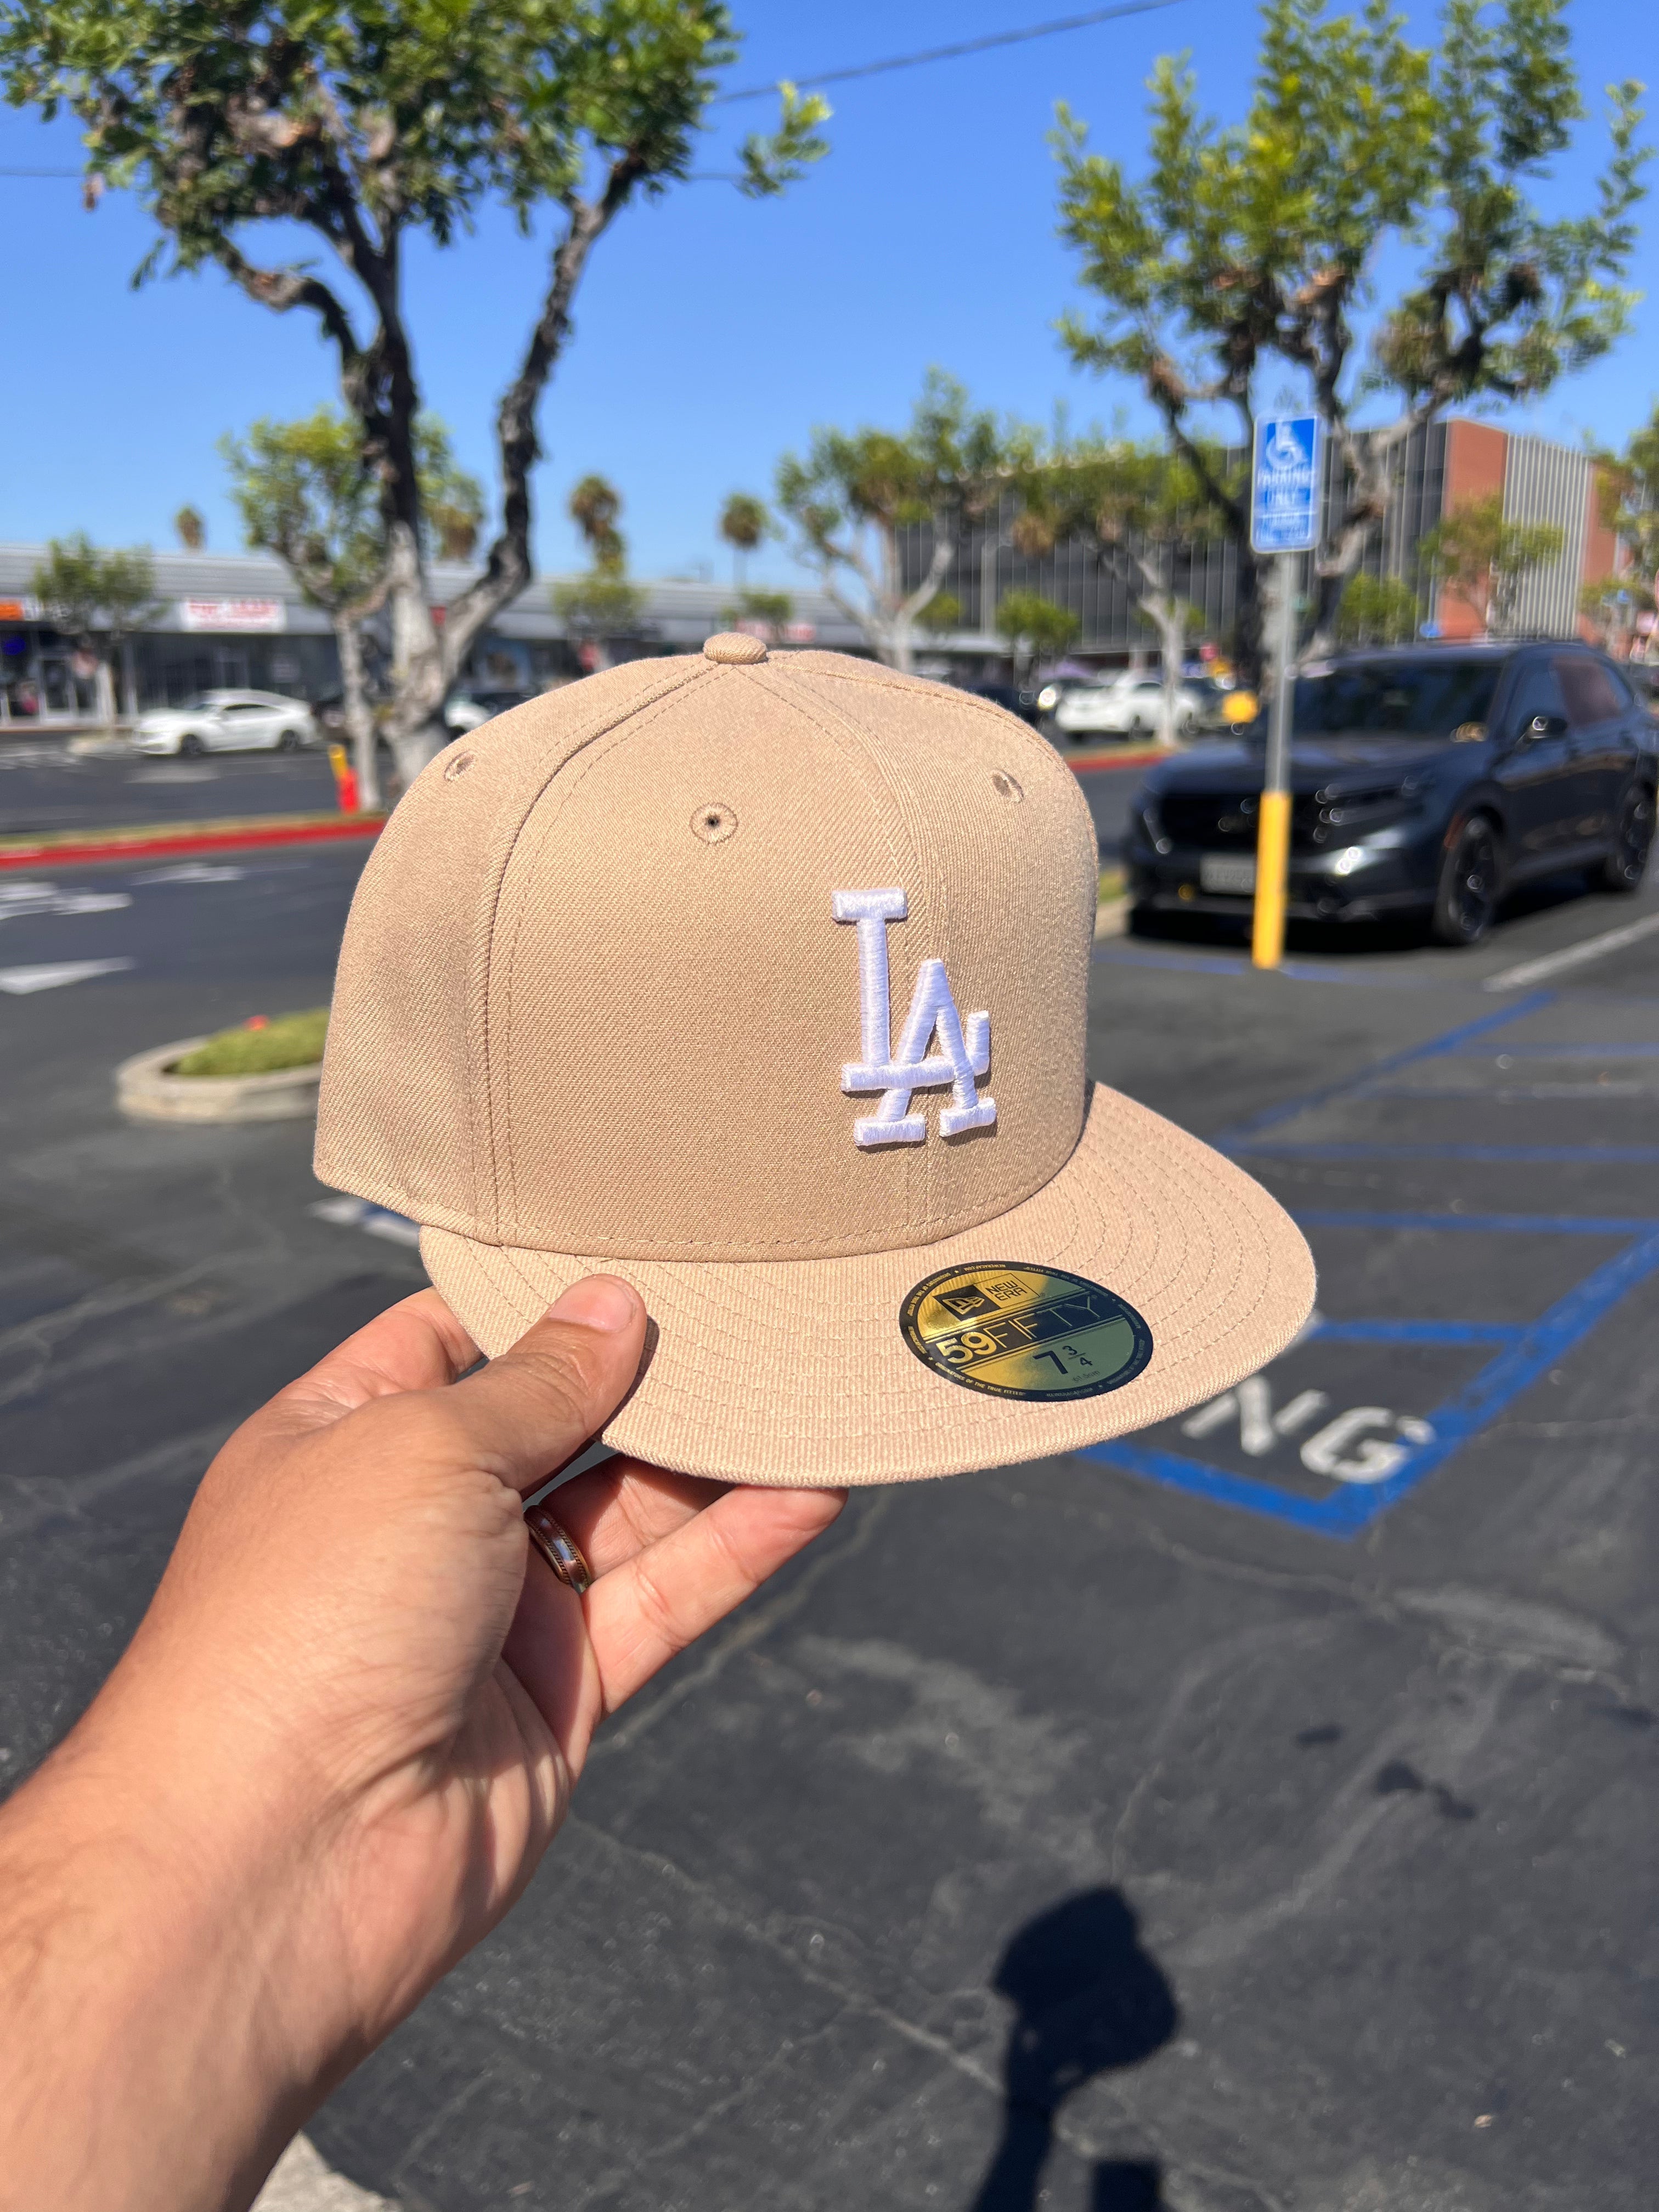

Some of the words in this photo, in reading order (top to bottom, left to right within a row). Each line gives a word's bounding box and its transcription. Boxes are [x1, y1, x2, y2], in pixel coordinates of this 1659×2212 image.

[831, 887, 997, 1146] LA
[985, 1280, 1019, 1295] NEW
[995, 1287, 1028, 1301] ERA
[936, 1296, 1101, 1364] 59FIFTY
